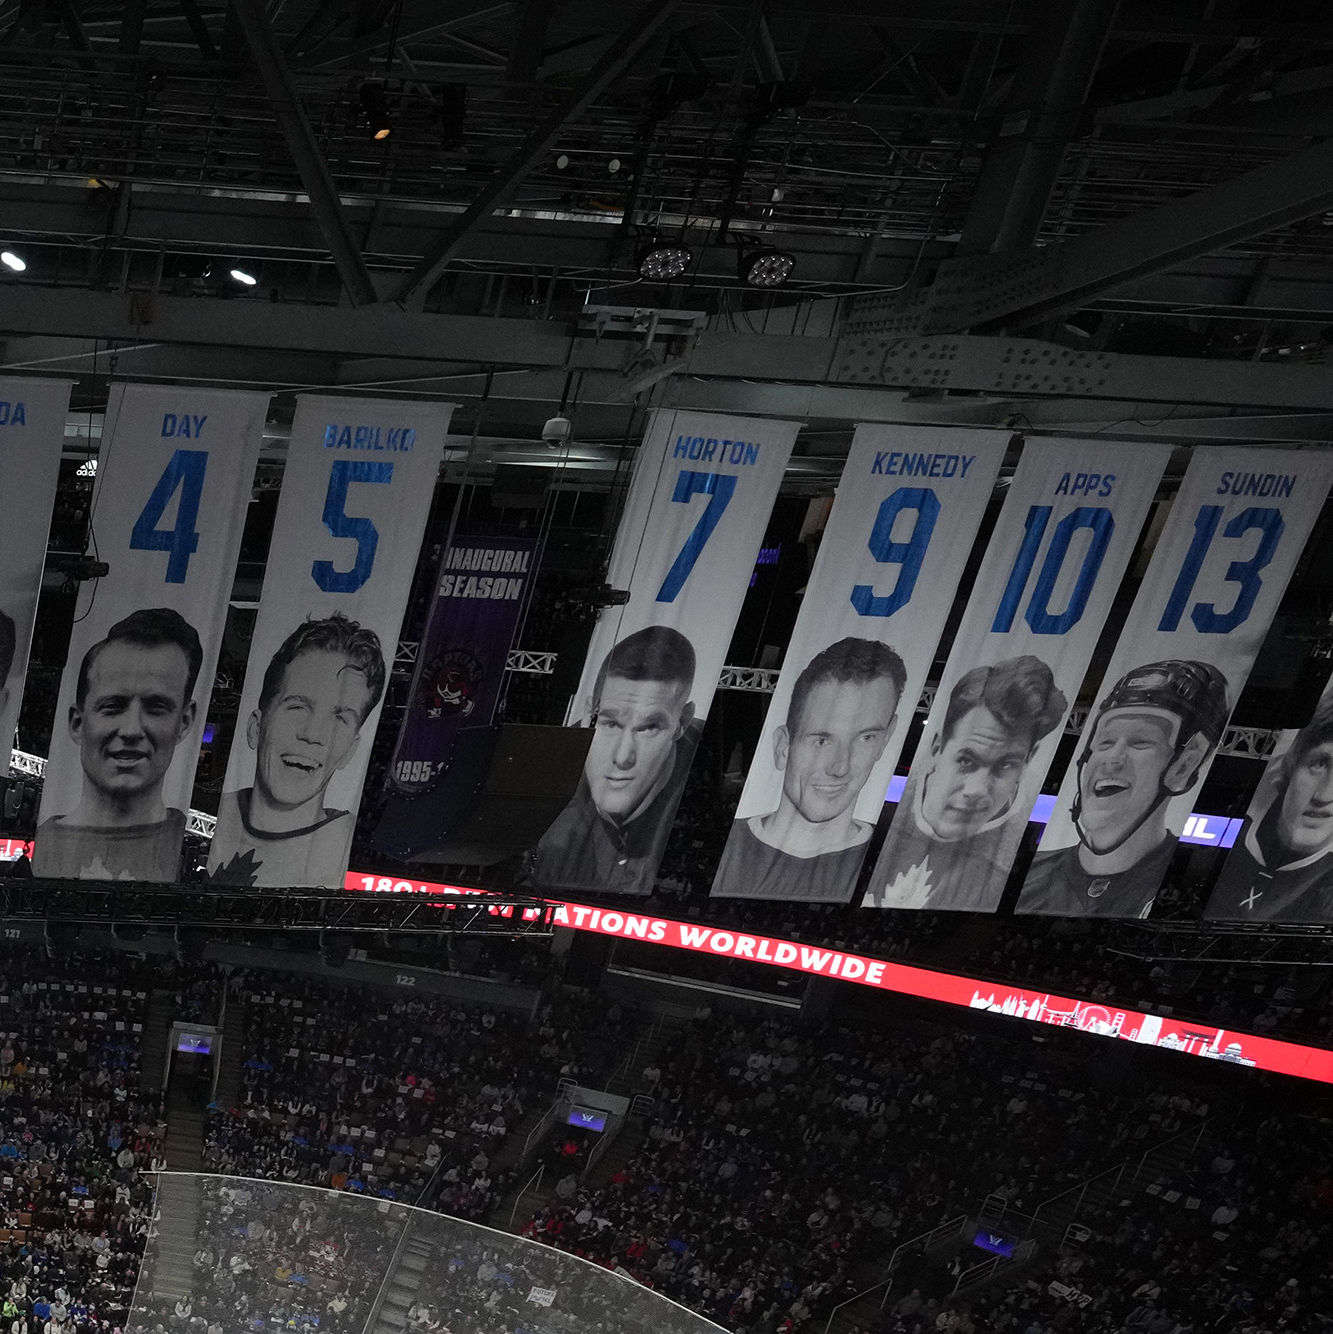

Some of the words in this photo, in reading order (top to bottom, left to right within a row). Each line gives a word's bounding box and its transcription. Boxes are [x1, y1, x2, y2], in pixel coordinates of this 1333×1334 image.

[161, 413, 208, 439] DAY
[323, 423, 417, 453] BARILKO
[672, 434, 761, 467] HORTON
[870, 451, 978, 479] KENNEDY
[1054, 472, 1117, 499] APPS
[1216, 471, 1298, 499] SUNDIN
[129, 449, 210, 585] 4
[311, 459, 395, 594] 5
[654, 470, 739, 603] 7
[849, 486, 943, 617] 9
[445, 547, 531, 574] INAUGURAL
[989, 504, 1117, 635] 10
[1156, 504, 1286, 634] 13
[439, 575, 524, 600] SEASON
[3, 928, 21, 940] 121
[679, 923, 888, 986] WORLDWIDE
[395, 974, 416, 987] 122
